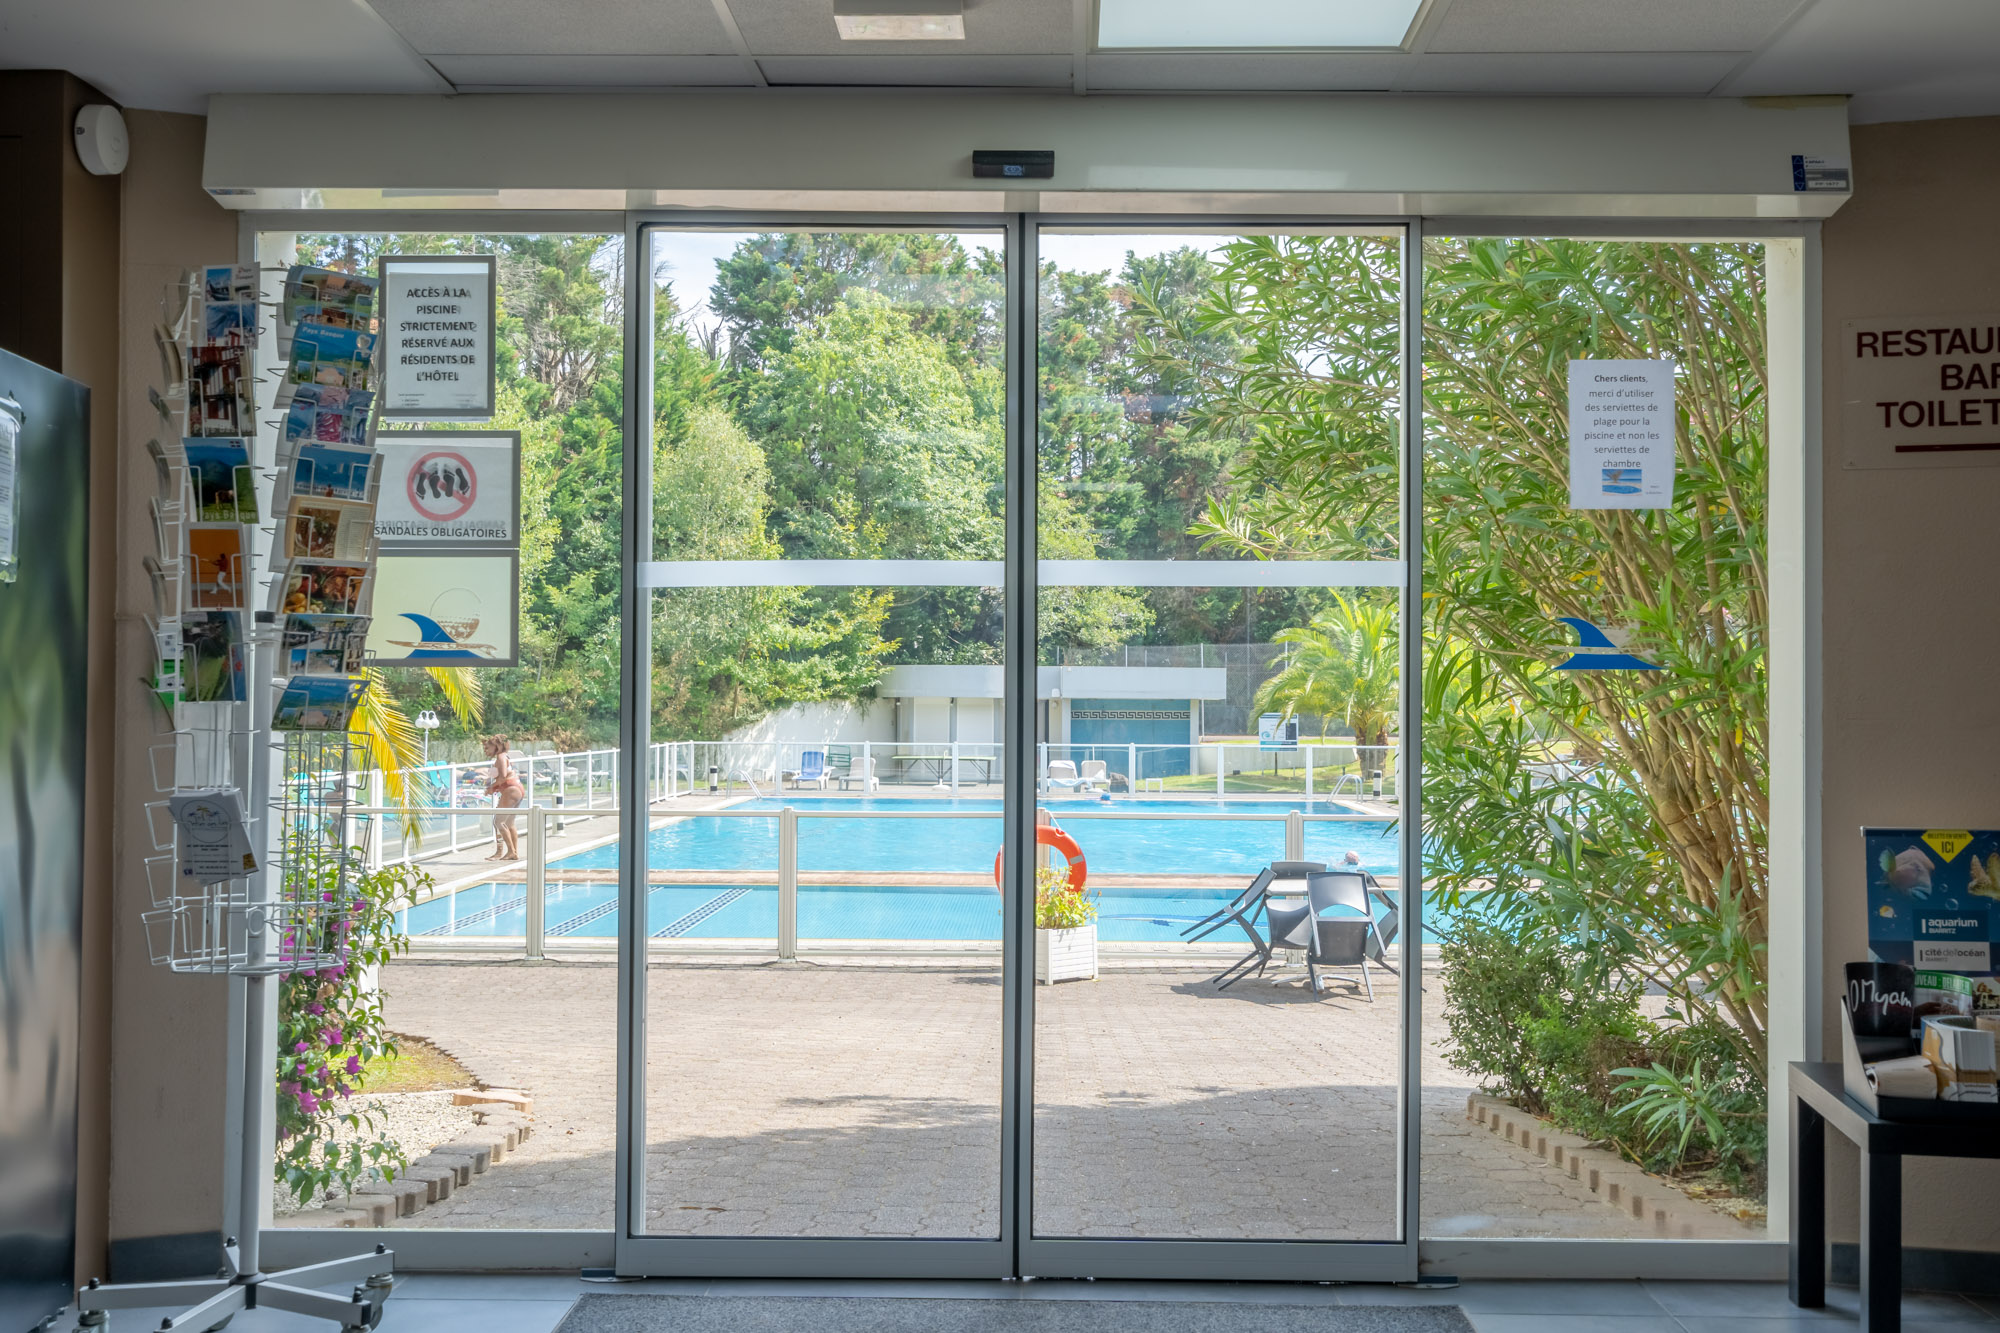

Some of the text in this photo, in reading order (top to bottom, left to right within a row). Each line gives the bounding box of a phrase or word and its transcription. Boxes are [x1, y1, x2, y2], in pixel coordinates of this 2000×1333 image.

[406, 286, 467, 298] ACCÈS À LA
[416, 305, 457, 314] PISCINE
[400, 322, 474, 331] STRICTEMENT
[402, 336, 474, 348] RÉSERVÉ AUX
[1857, 327, 2000, 358] RESTAU
[401, 353, 475, 365] RÉSIDENTS DE
[416, 370, 459, 381] L'HÔTEL
[1620, 375, 1648, 384] clients,
[1594, 418, 1617, 427] plage
[1584, 432, 1614, 441] piscine
[224, 510, 256, 522] Baque
[375, 527, 507, 538] SANDALES OBLIGATOIRES
[1942, 841, 1954, 853] ICI
[1928, 918, 1978, 927] aquarium
[1914, 975, 1937, 986] UVEAU
